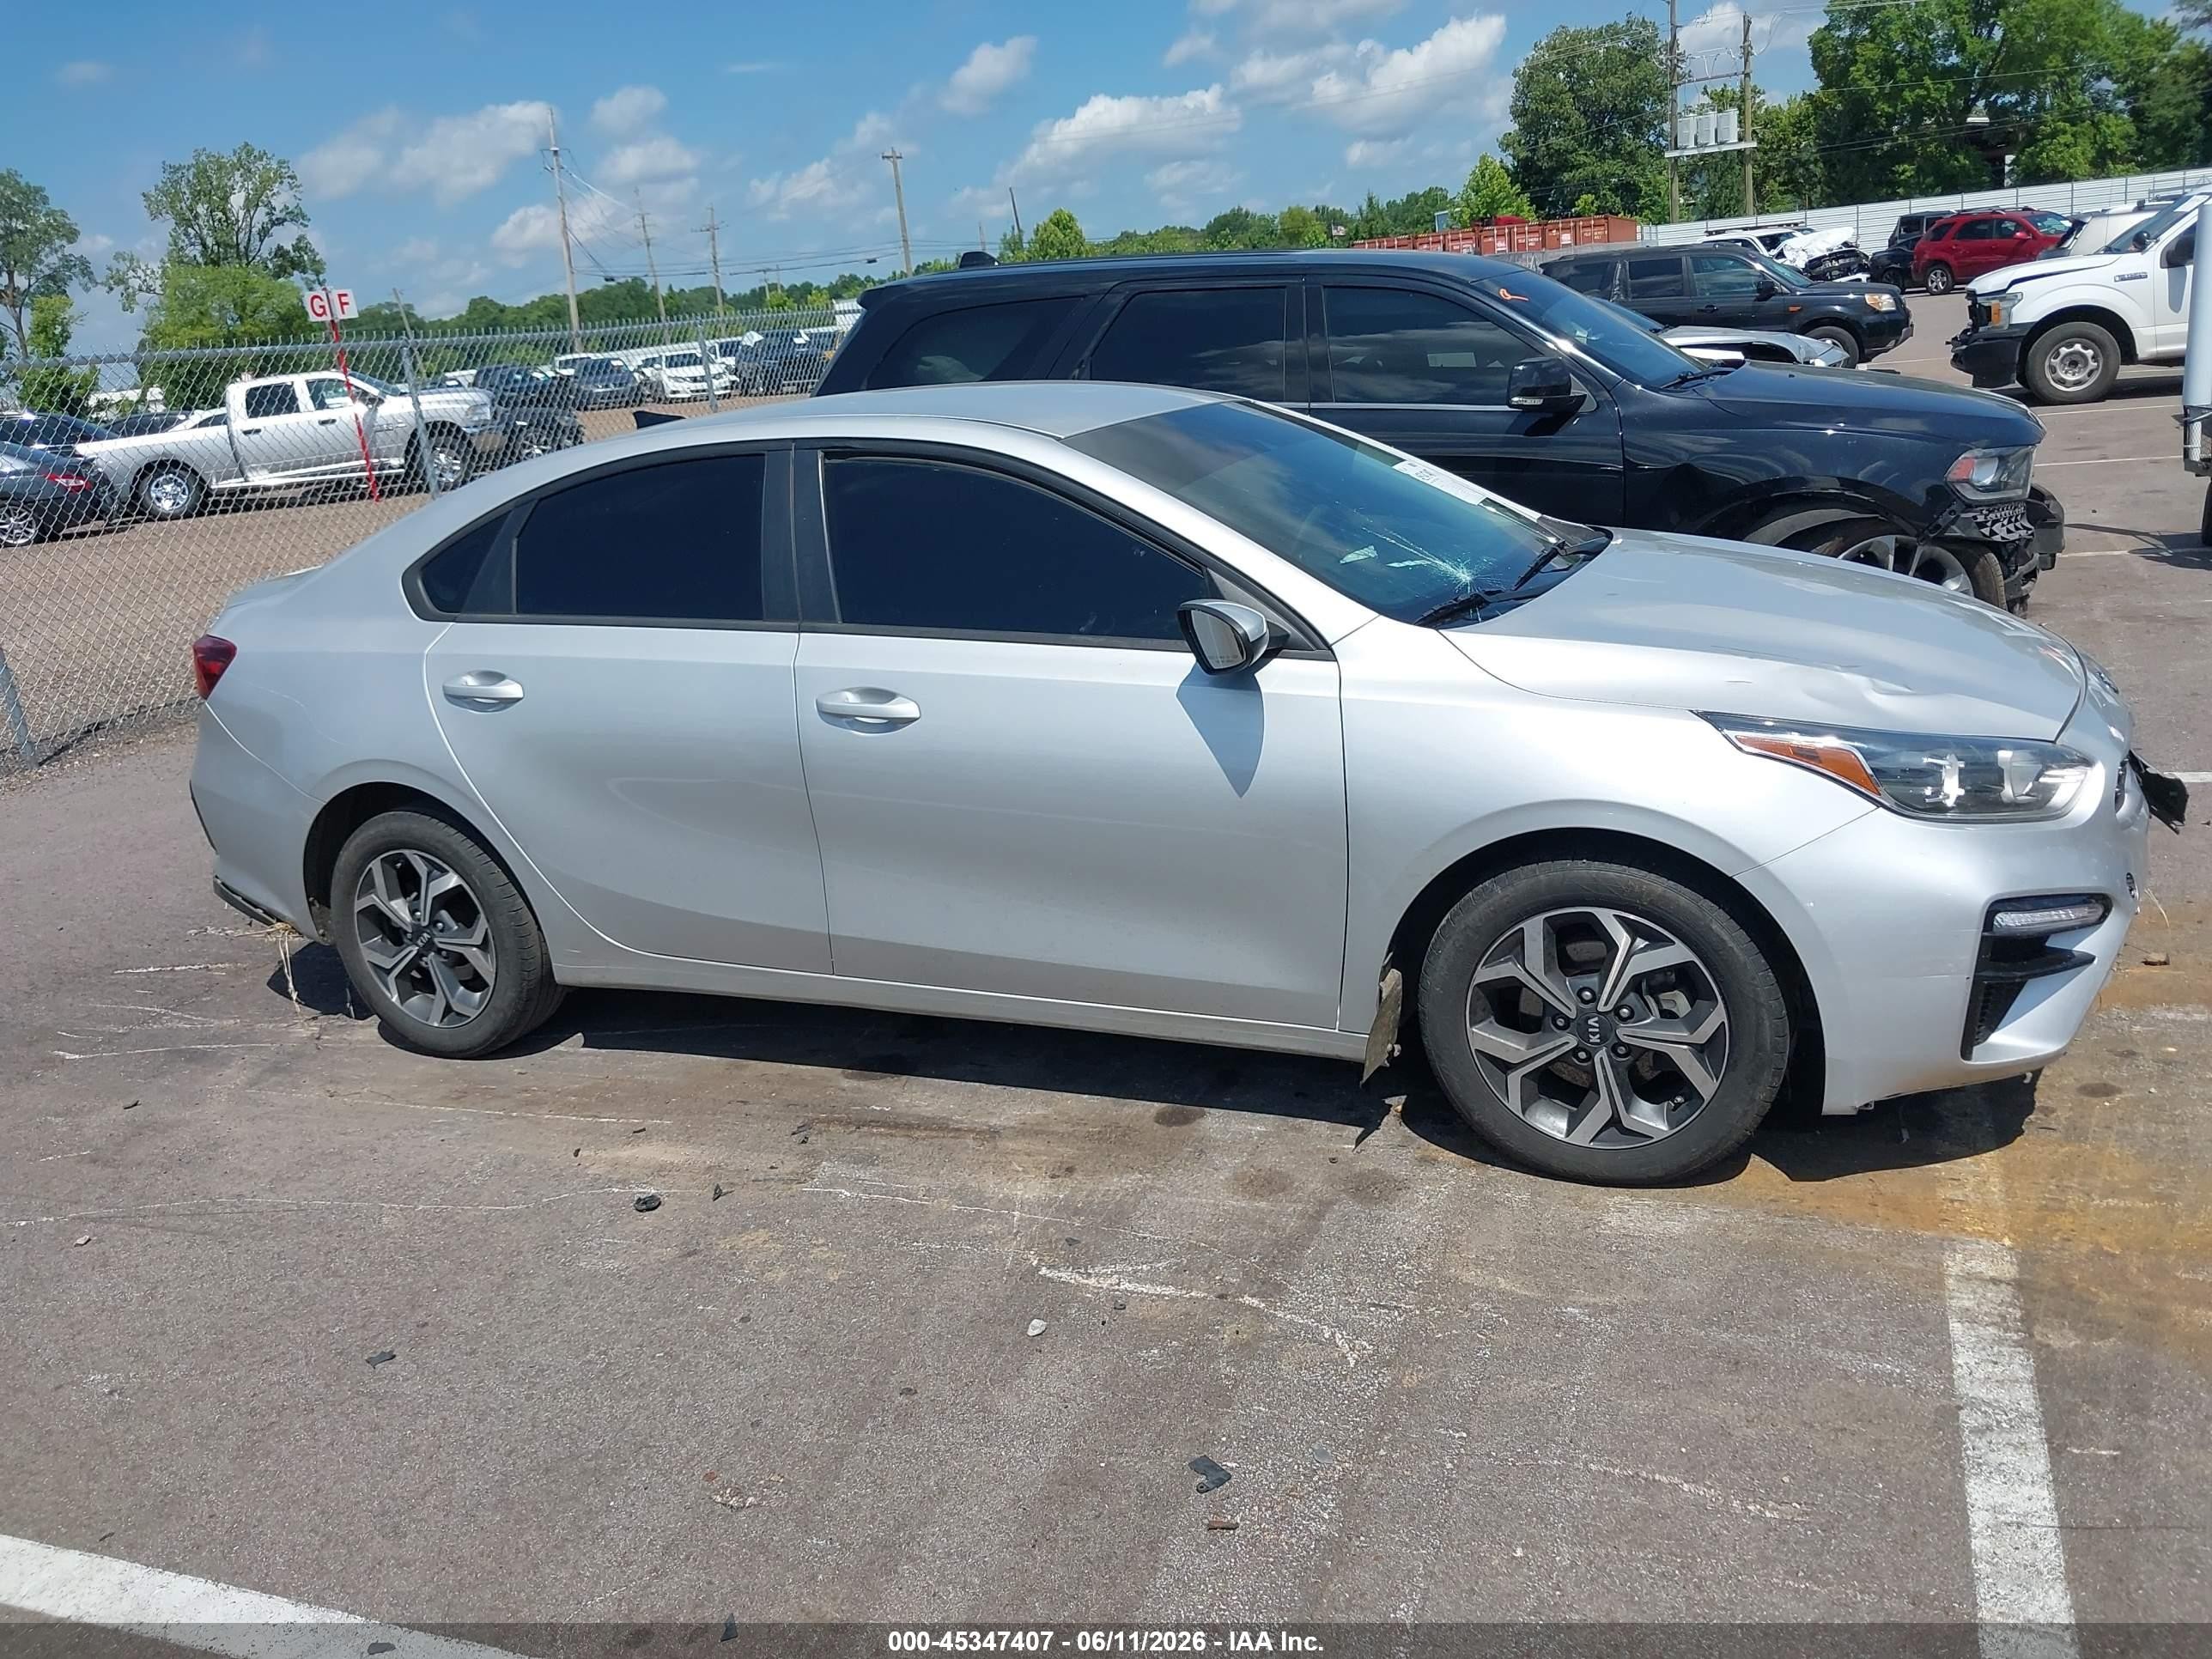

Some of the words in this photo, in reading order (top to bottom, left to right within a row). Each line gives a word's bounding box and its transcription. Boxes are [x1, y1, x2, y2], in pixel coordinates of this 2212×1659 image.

[310, 295, 328, 318] G
[337, 293, 350, 315] F
[1587, 1016, 1601, 1043] KIA
